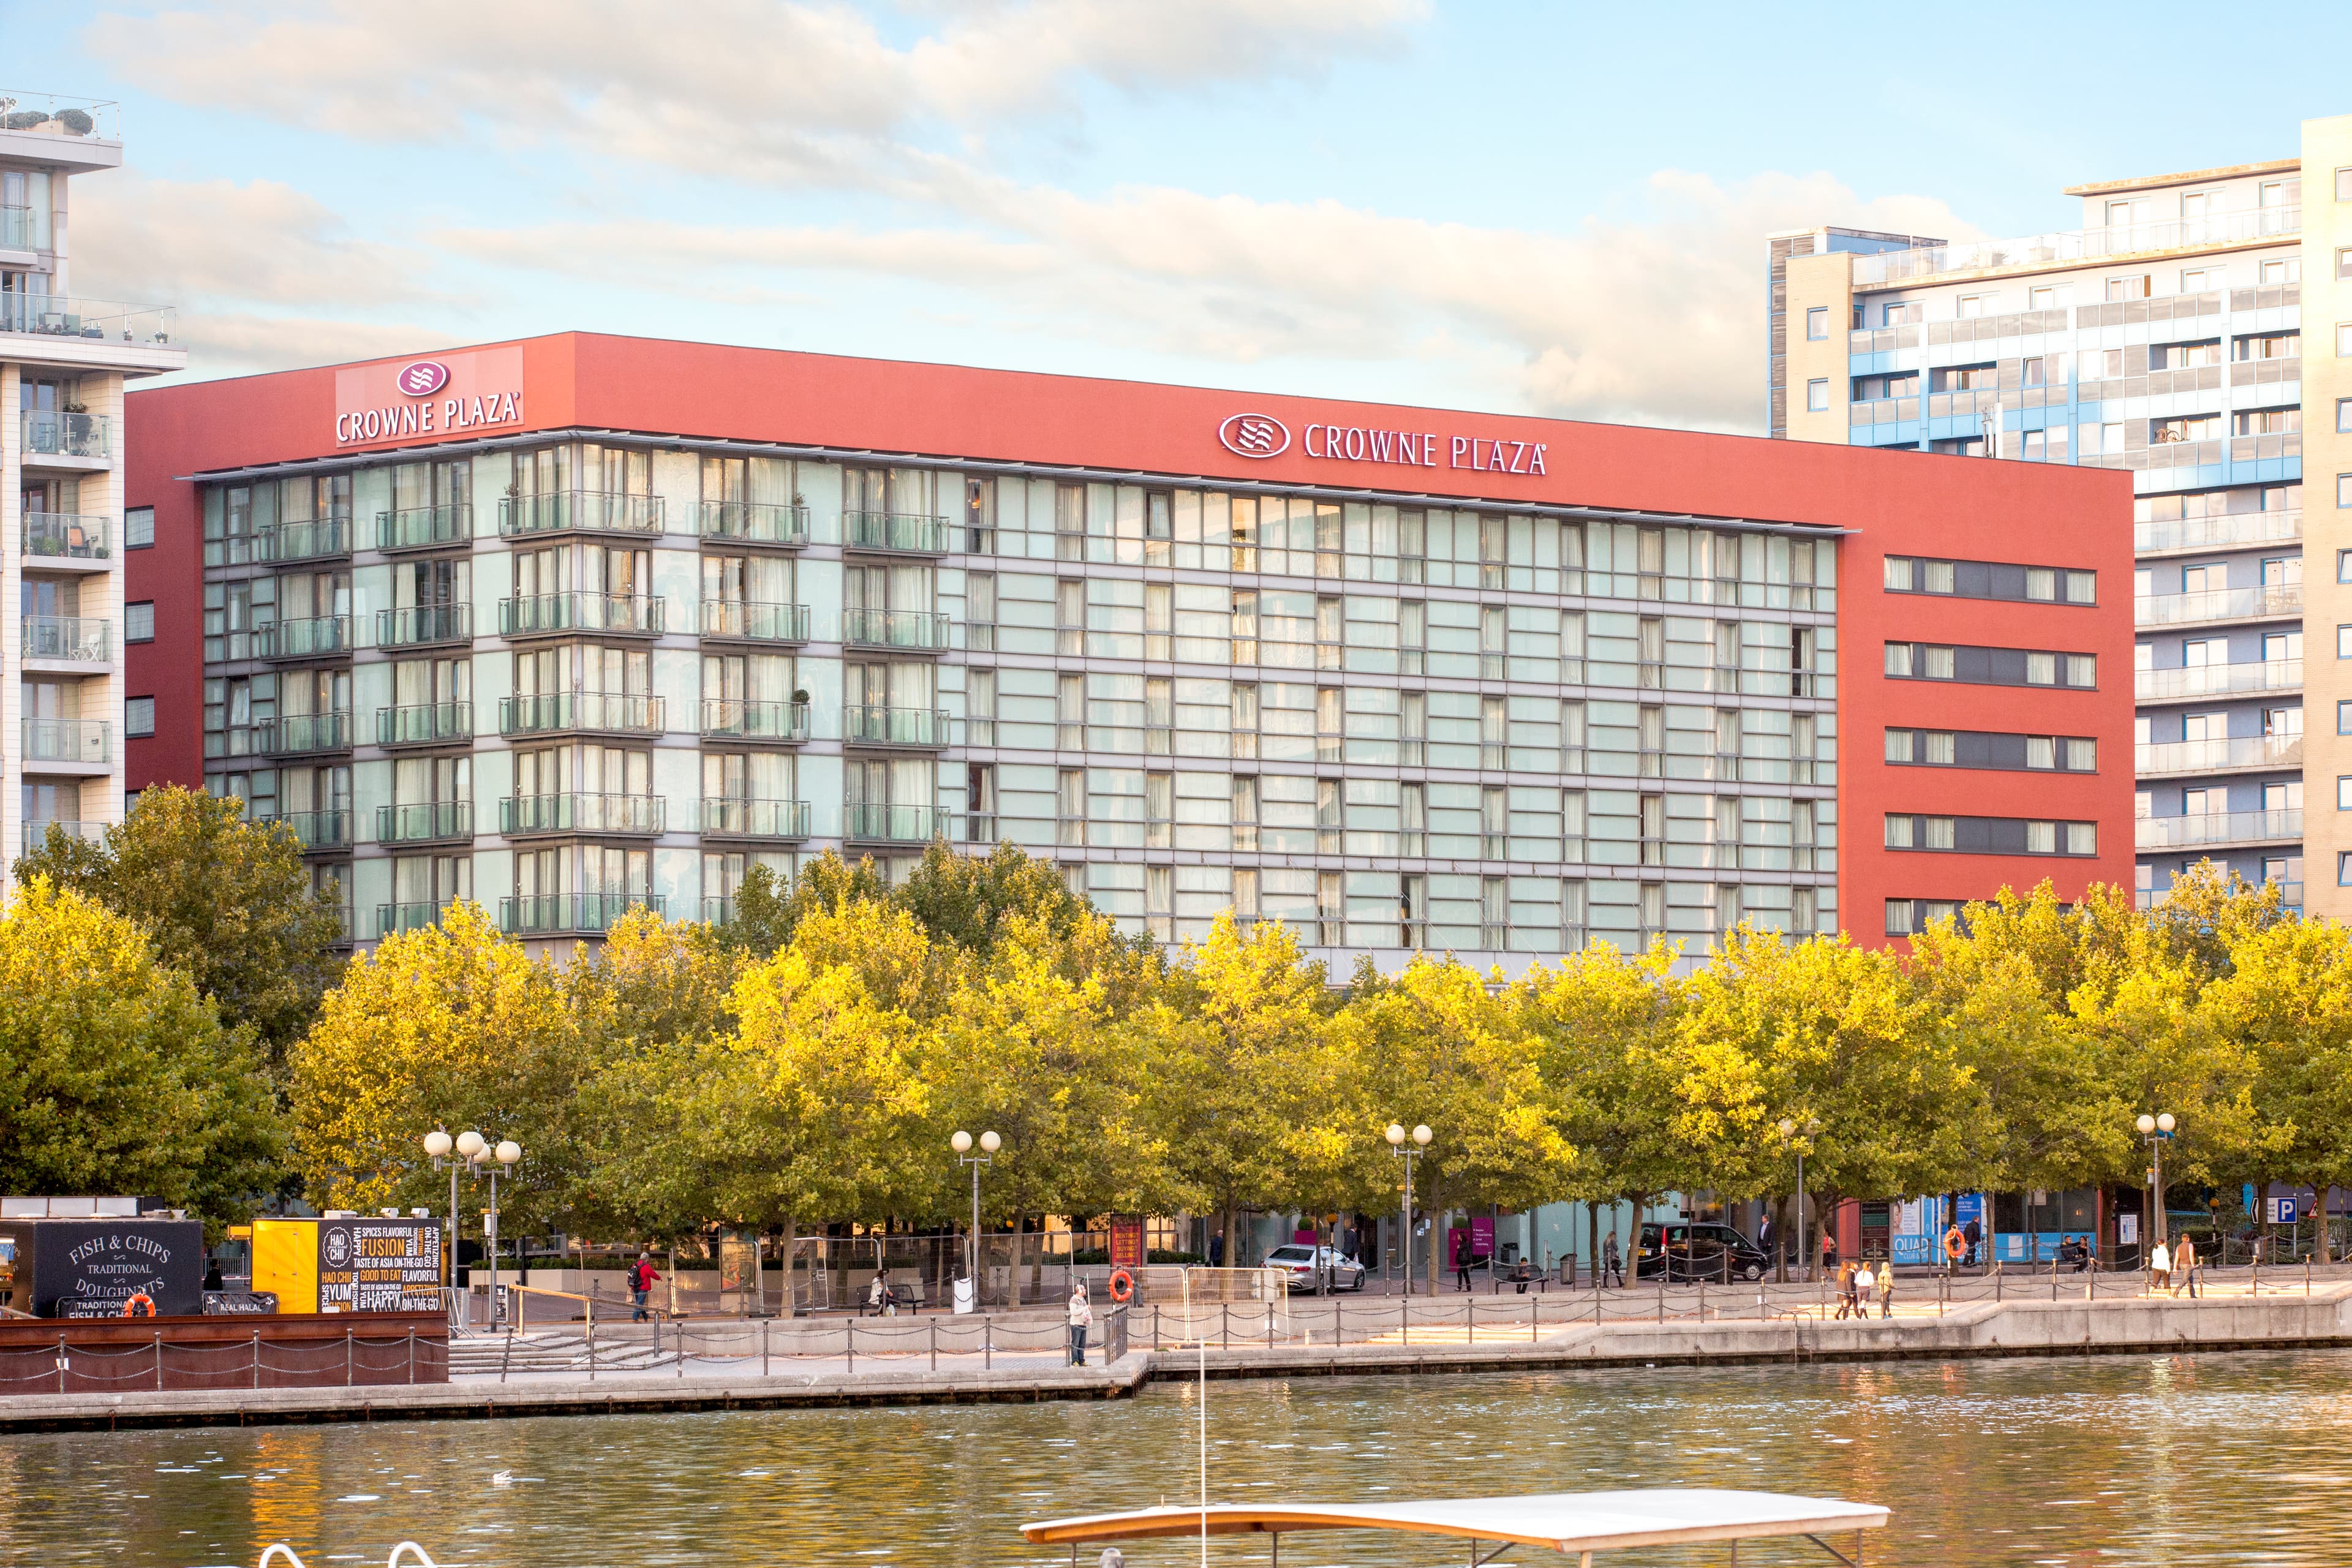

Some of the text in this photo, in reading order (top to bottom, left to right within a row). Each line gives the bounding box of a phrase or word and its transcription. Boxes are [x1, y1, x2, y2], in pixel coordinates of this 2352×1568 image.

[336, 402, 434, 442] CROWNE
[1305, 423, 1437, 467] CROWNE
[2281, 1201, 2294, 1220] P
[362, 1227, 413, 1237] SPICES FLAVORFUL
[330, 1234, 345, 1245] HAO
[69, 1235, 171, 1265] FISH & CHIPS
[361, 1238, 405, 1256] FUSION
[1894, 1238, 1928, 1255] QUAD
[330, 1249, 344, 1260] CHII
[353, 1257, 423, 1268] TASTE OF ASIA ON-THE-GO
[87, 1264, 152, 1274] TRADITIONAL
[360, 1269, 401, 1281] GOOD TO EAT
[322, 1272, 352, 1283] HAO CHII
[402, 1270, 439, 1281] FLAVORFUL
[75, 1276, 165, 1297] DOUGHNUTS
[330, 1284, 352, 1300] YUM
[402, 1284, 439, 1296] APPETIZING
[77, 1301, 127, 1310] TRADITIONA
[367, 1291, 402, 1308] HAPPY
[402, 1298, 439, 1311] ON-THE-GO
